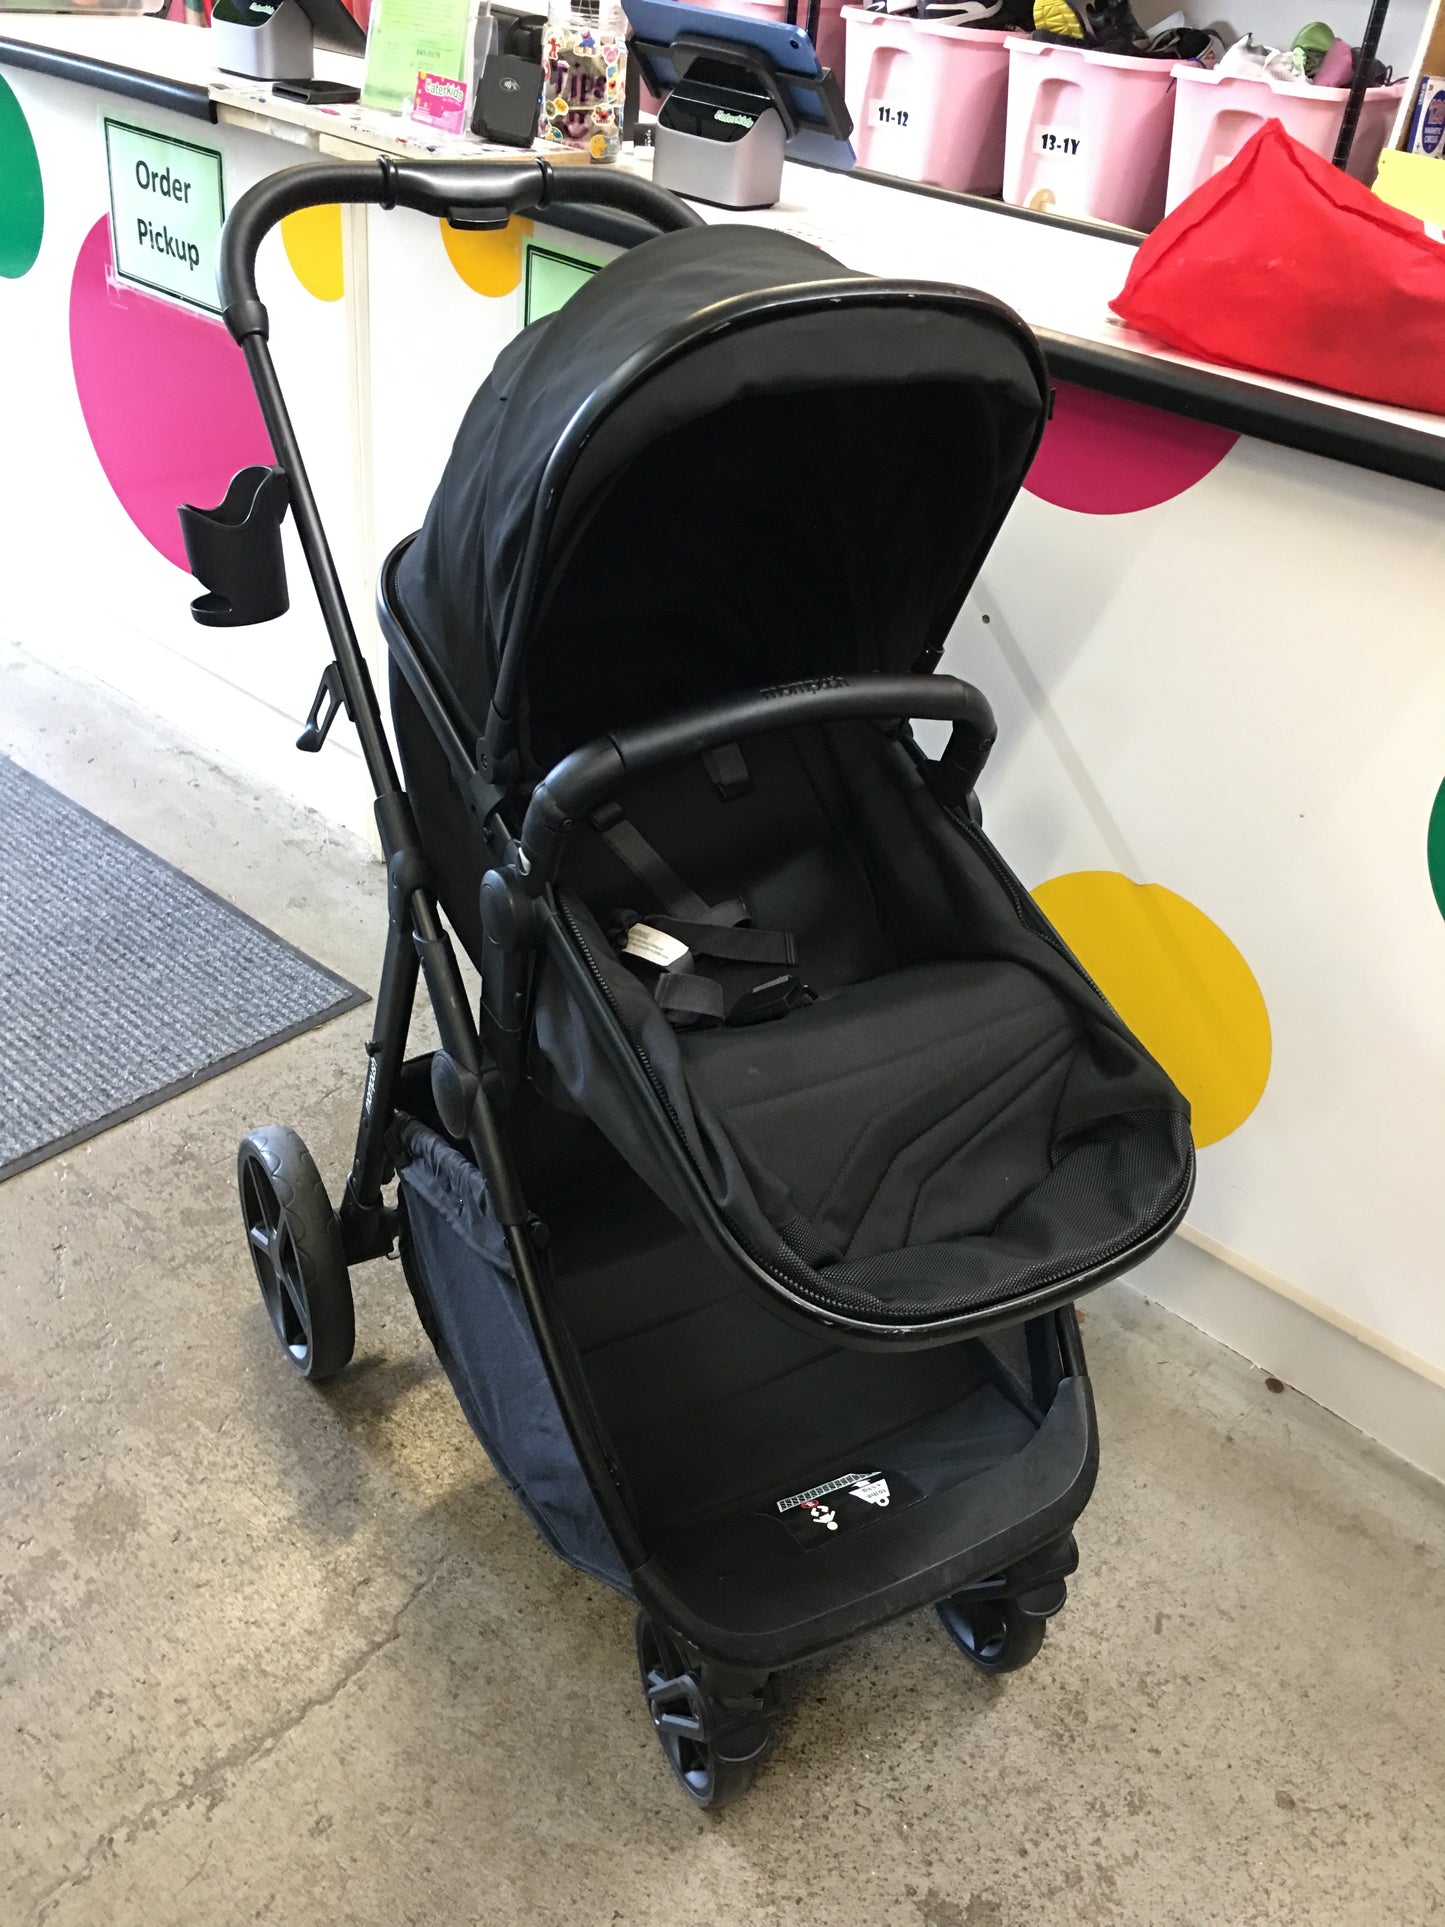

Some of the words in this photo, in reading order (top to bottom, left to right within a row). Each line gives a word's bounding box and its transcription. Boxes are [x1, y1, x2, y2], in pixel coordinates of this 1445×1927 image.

[878, 106, 909, 127] 11-12
[1042, 133, 1080, 155] 13-1Y
[135, 160, 191, 204] Order
[137, 218, 200, 271] Pickup
